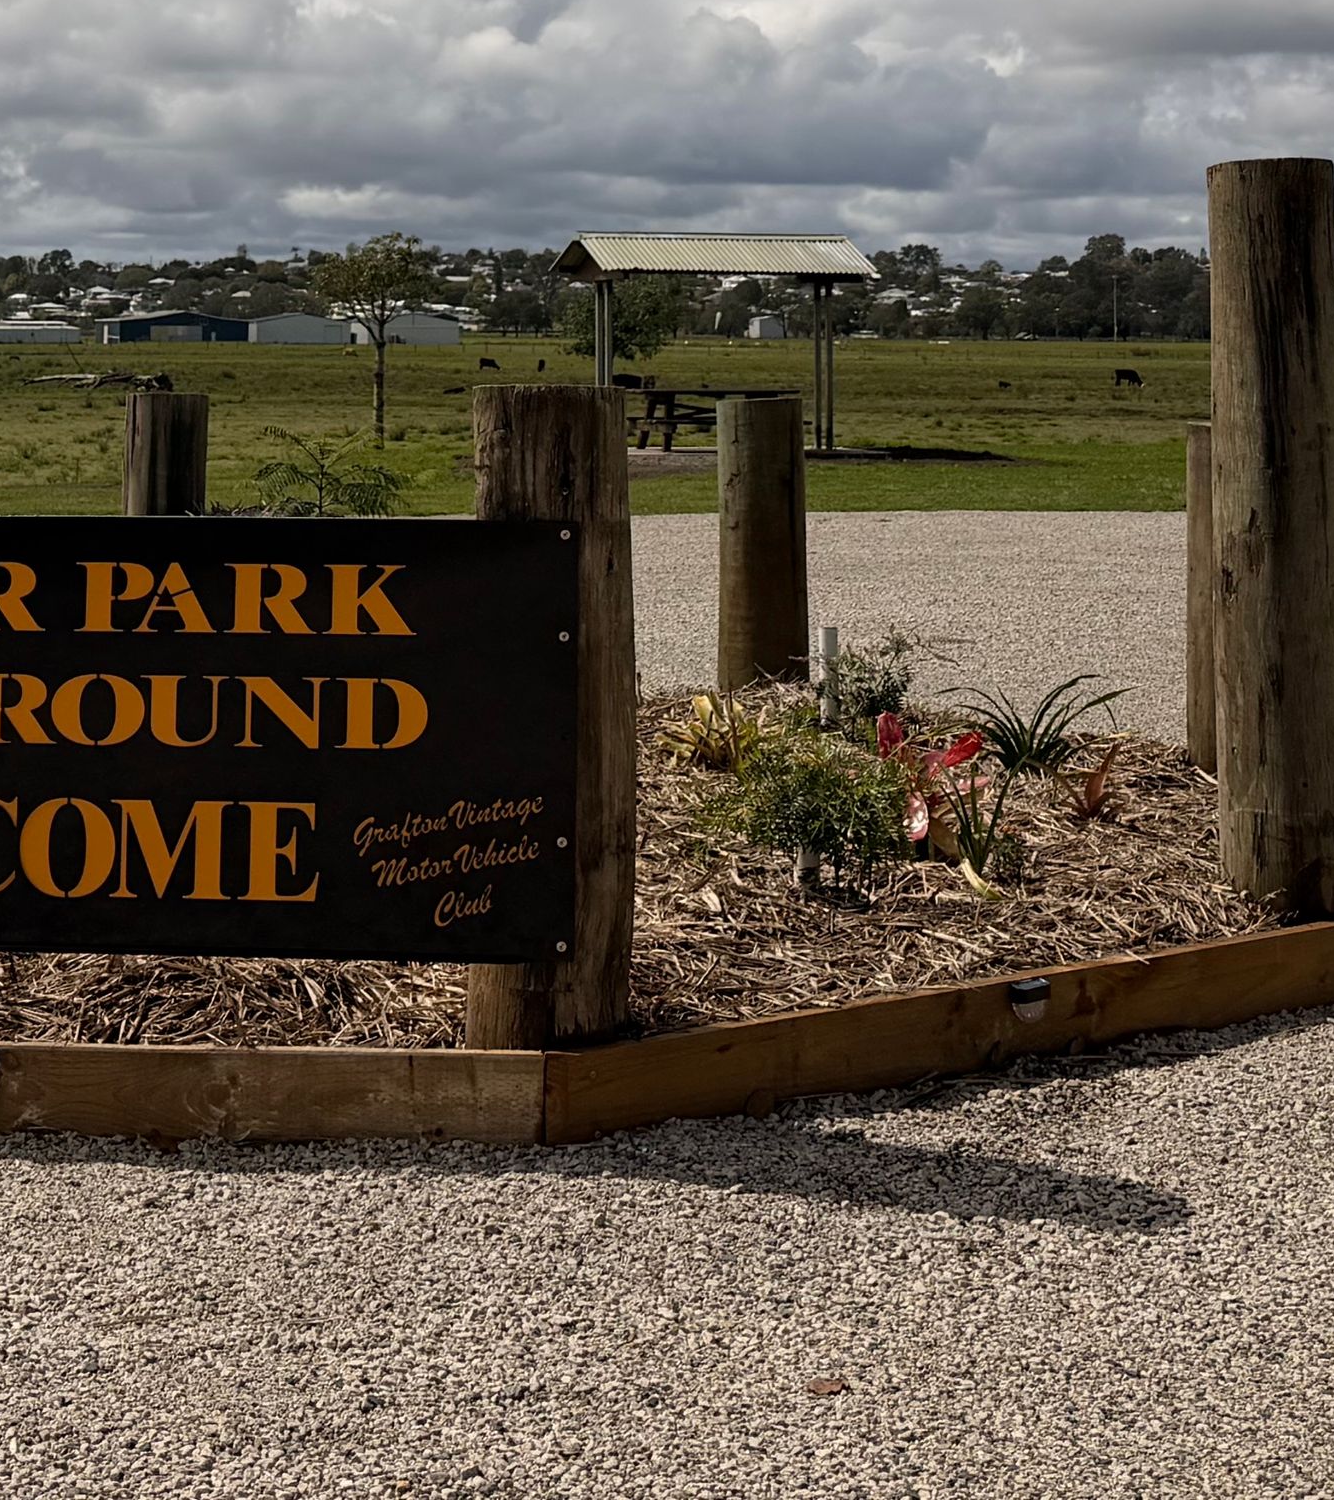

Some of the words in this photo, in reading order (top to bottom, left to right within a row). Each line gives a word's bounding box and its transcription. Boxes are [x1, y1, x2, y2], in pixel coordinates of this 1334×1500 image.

[75, 560, 415, 636] PARK
[353, 812, 448, 857] Grafton
[448, 796, 544, 829] Vintage
[371, 857, 453, 887] Motor
[453, 835, 540, 873] Vehicle
[434, 884, 493, 927] Club
